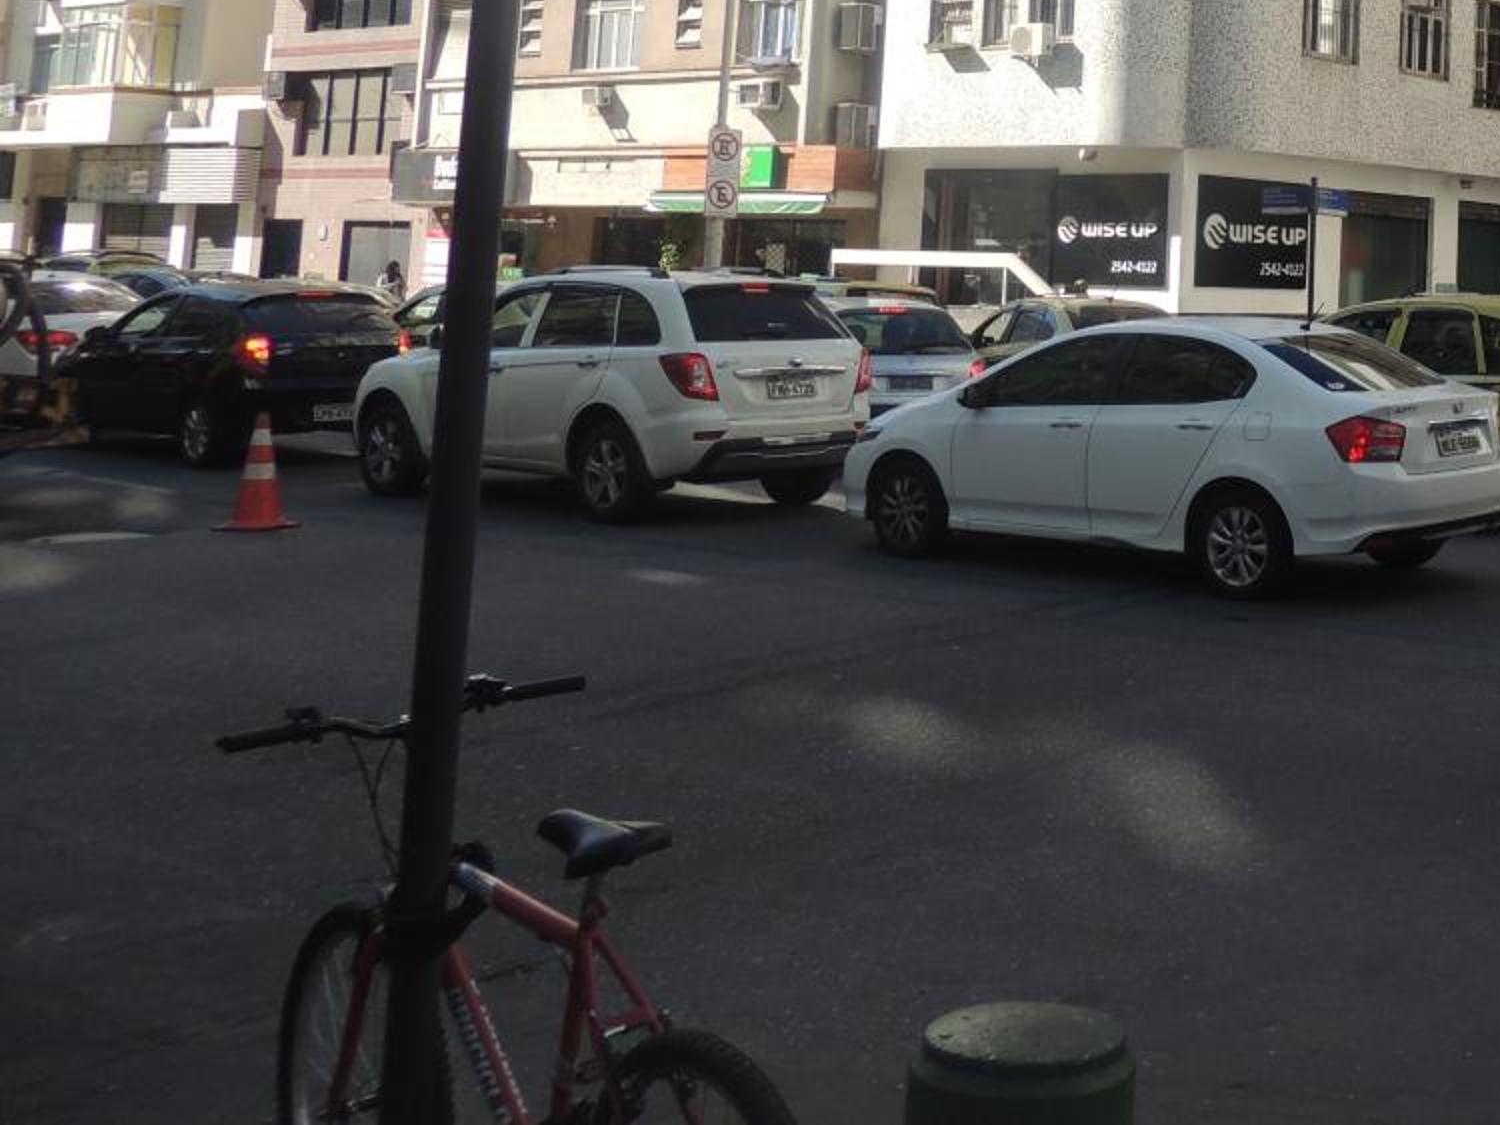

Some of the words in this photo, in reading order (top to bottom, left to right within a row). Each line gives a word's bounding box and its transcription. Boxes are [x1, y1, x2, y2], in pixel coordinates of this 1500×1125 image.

[1080, 221, 1127, 238] WISE
[1130, 221, 1159, 238] UP
[1228, 224, 1280, 245] WISE
[1280, 228, 1307, 247] UP
